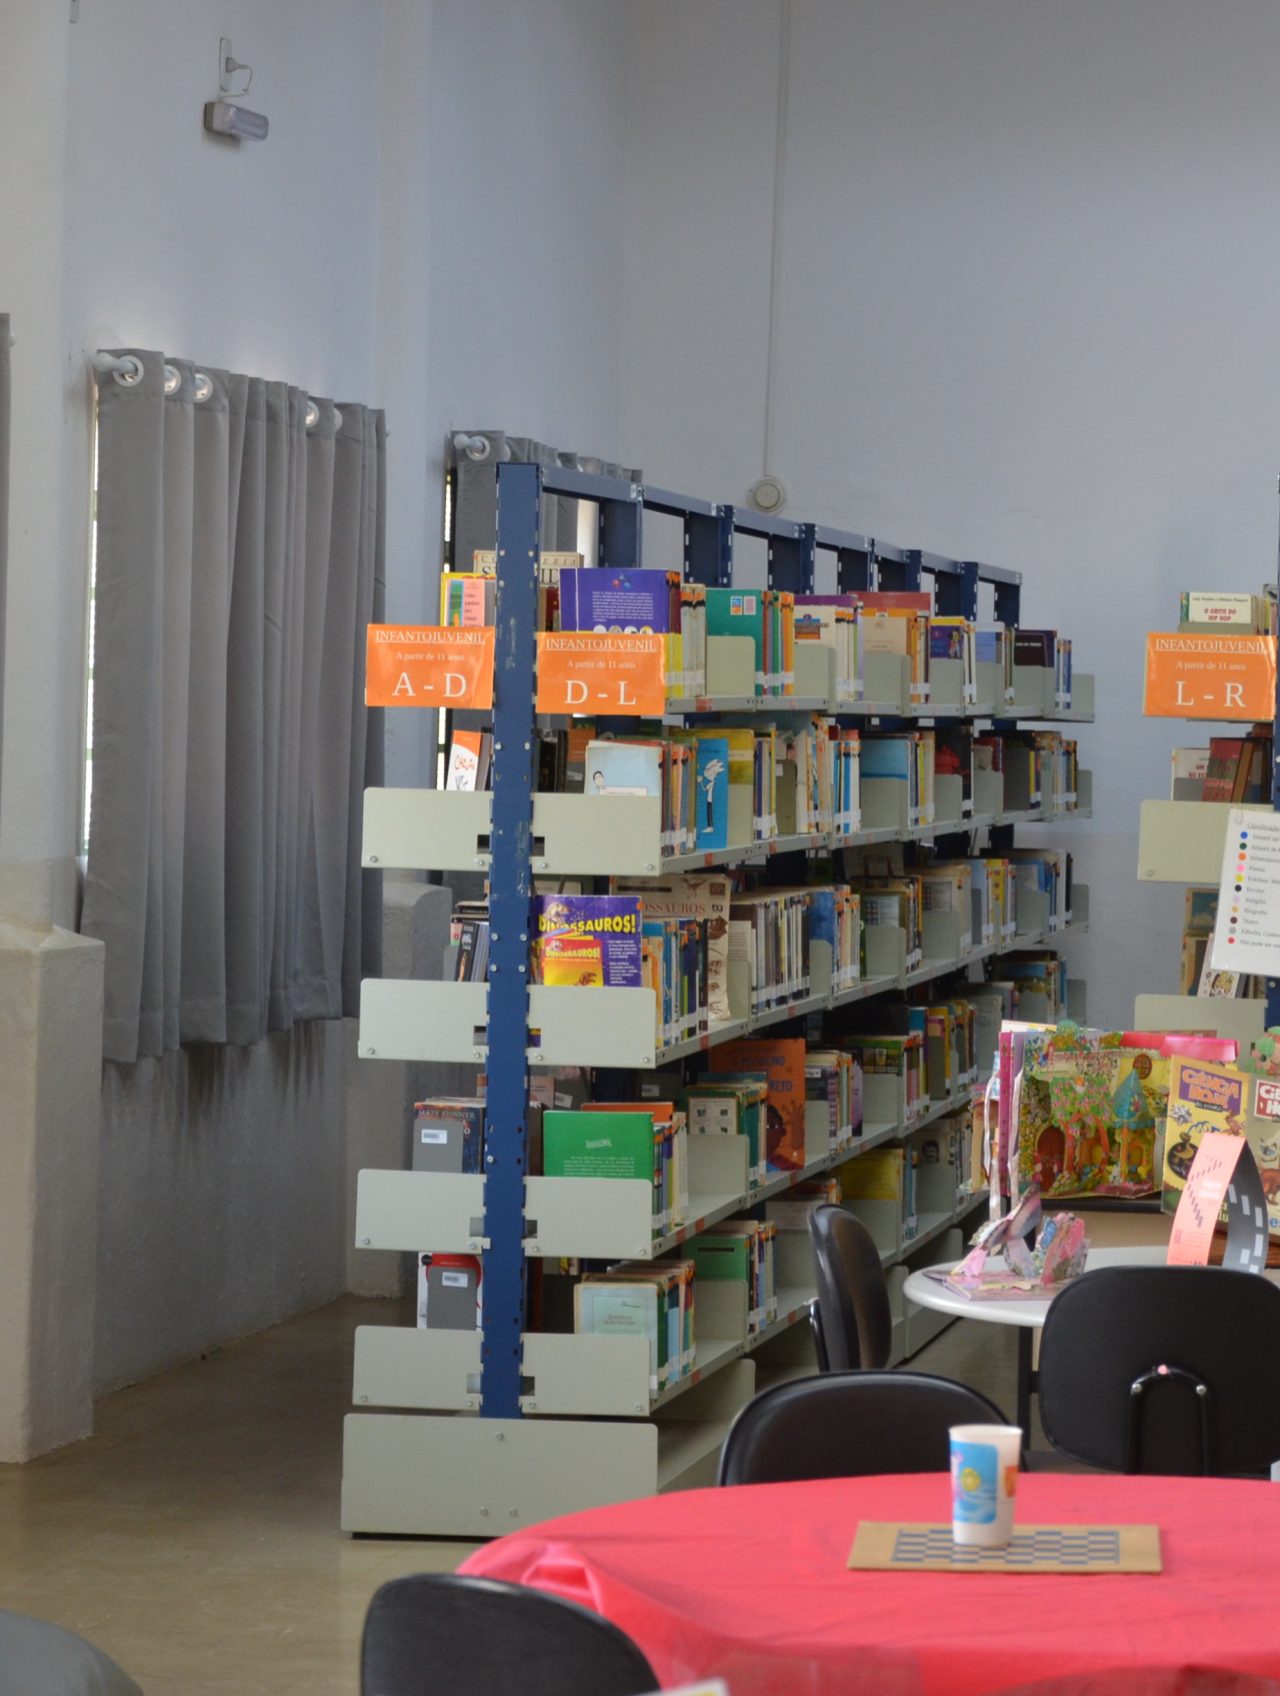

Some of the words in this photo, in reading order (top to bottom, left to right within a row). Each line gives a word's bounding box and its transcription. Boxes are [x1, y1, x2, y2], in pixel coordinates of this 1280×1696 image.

[376, 630, 485, 643] INFANTOJUVENIL
[545, 638, 657, 652] INFANTOJUVENIL
[1155, 638, 1266, 654] INFANTOJUVENIL
[402, 652, 424, 662] partir
[426, 652, 434, 660] de
[438, 652, 445, 660] 11
[575, 660, 594, 670] partir
[596, 660, 606, 668] de
[608, 660, 616, 668] 11
[1176, 660, 1183, 669] A
[1184, 661, 1204, 672] partir
[1206, 662, 1216, 670] de
[1218, 662, 1226, 670] 11
[1229, 663, 1246, 671] anos
[392, 671, 416, 697] A
[443, 672, 467, 698] D
[564, 679, 589, 705] D
[616, 680, 637, 706] L
[1176, 680, 1195, 706] L
[1224, 682, 1247, 708] R
[538, 914, 636, 934] DINOSSAUROS!
[768, 1080, 794, 1092] RETO
